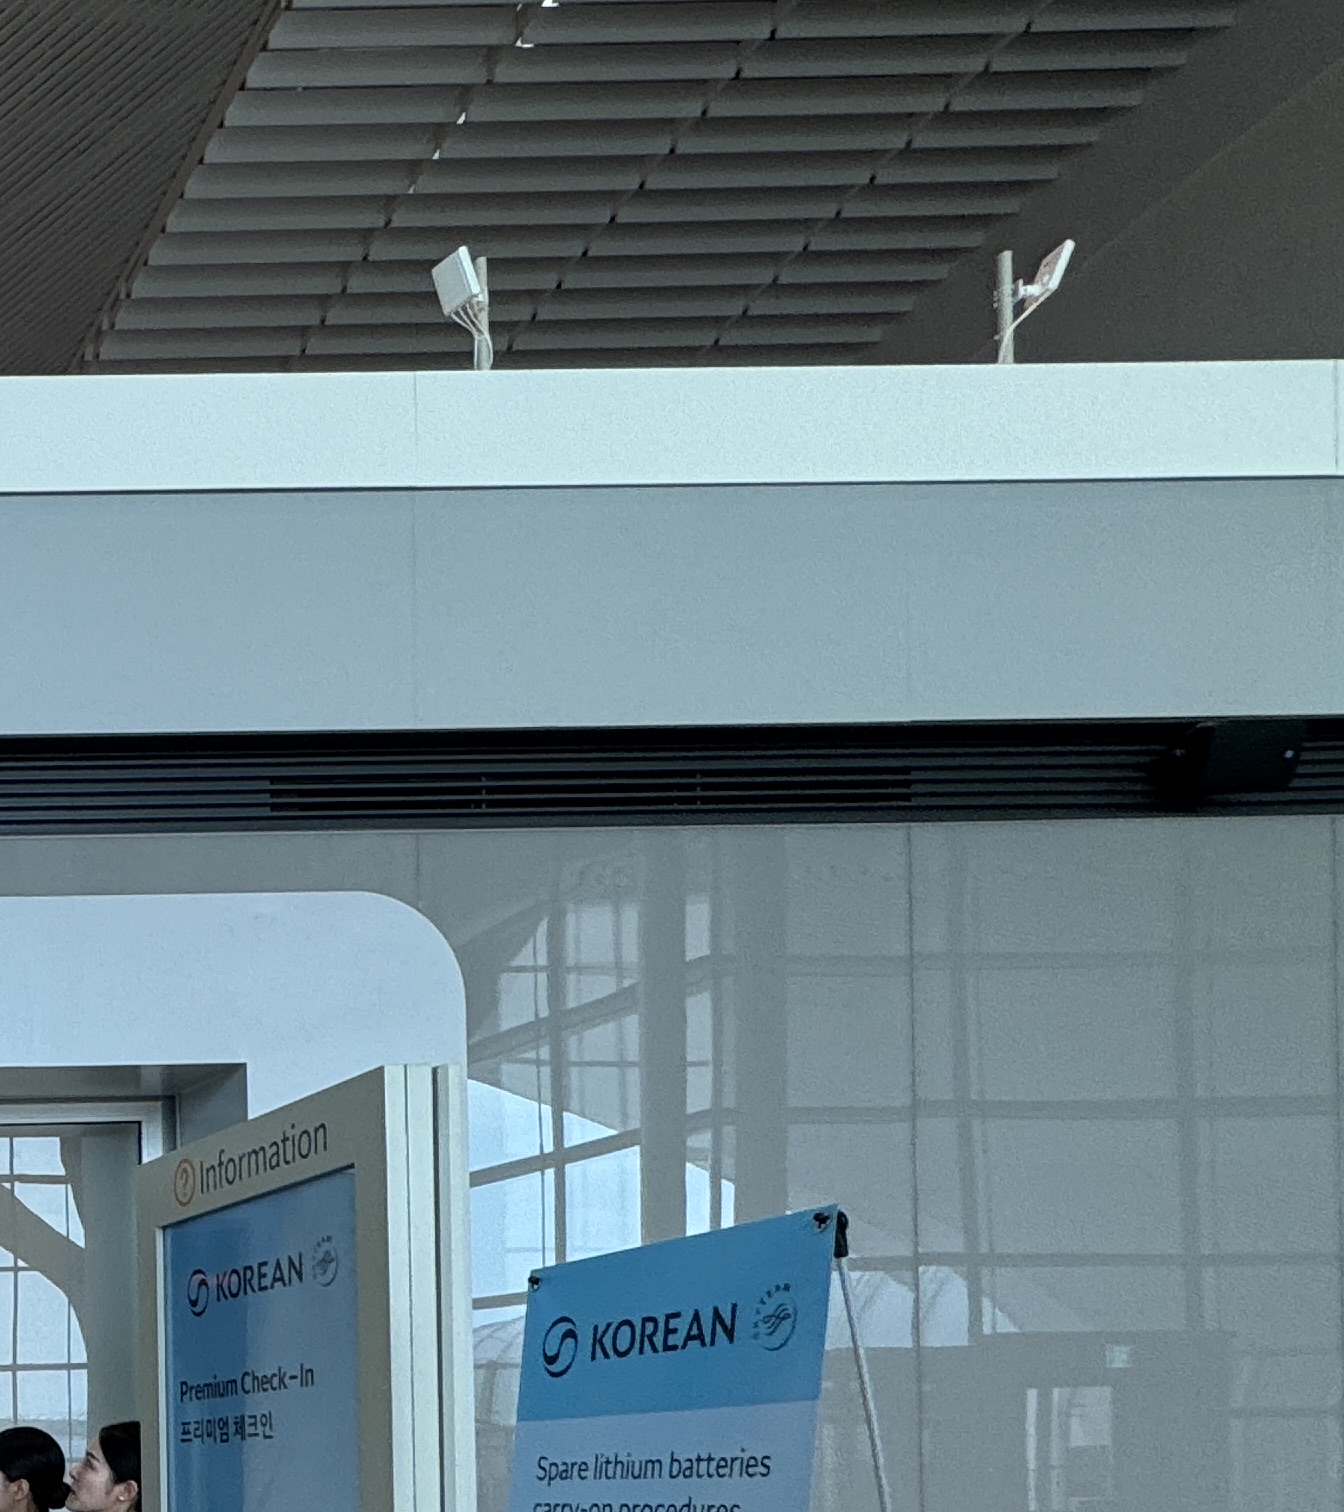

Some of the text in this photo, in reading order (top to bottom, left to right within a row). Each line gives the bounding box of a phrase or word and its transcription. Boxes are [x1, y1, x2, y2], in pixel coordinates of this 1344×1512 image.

[199, 1123, 328, 1195] Information
[216, 1252, 304, 1302] KOREAN
[591, 1302, 738, 1362] KOREAN
[180, 1363, 314, 1402] Premium Check-In
[180, 1410, 274, 1445] 프리미엄 체크인
[536, 1448, 772, 1487] Spare lithium batteries
